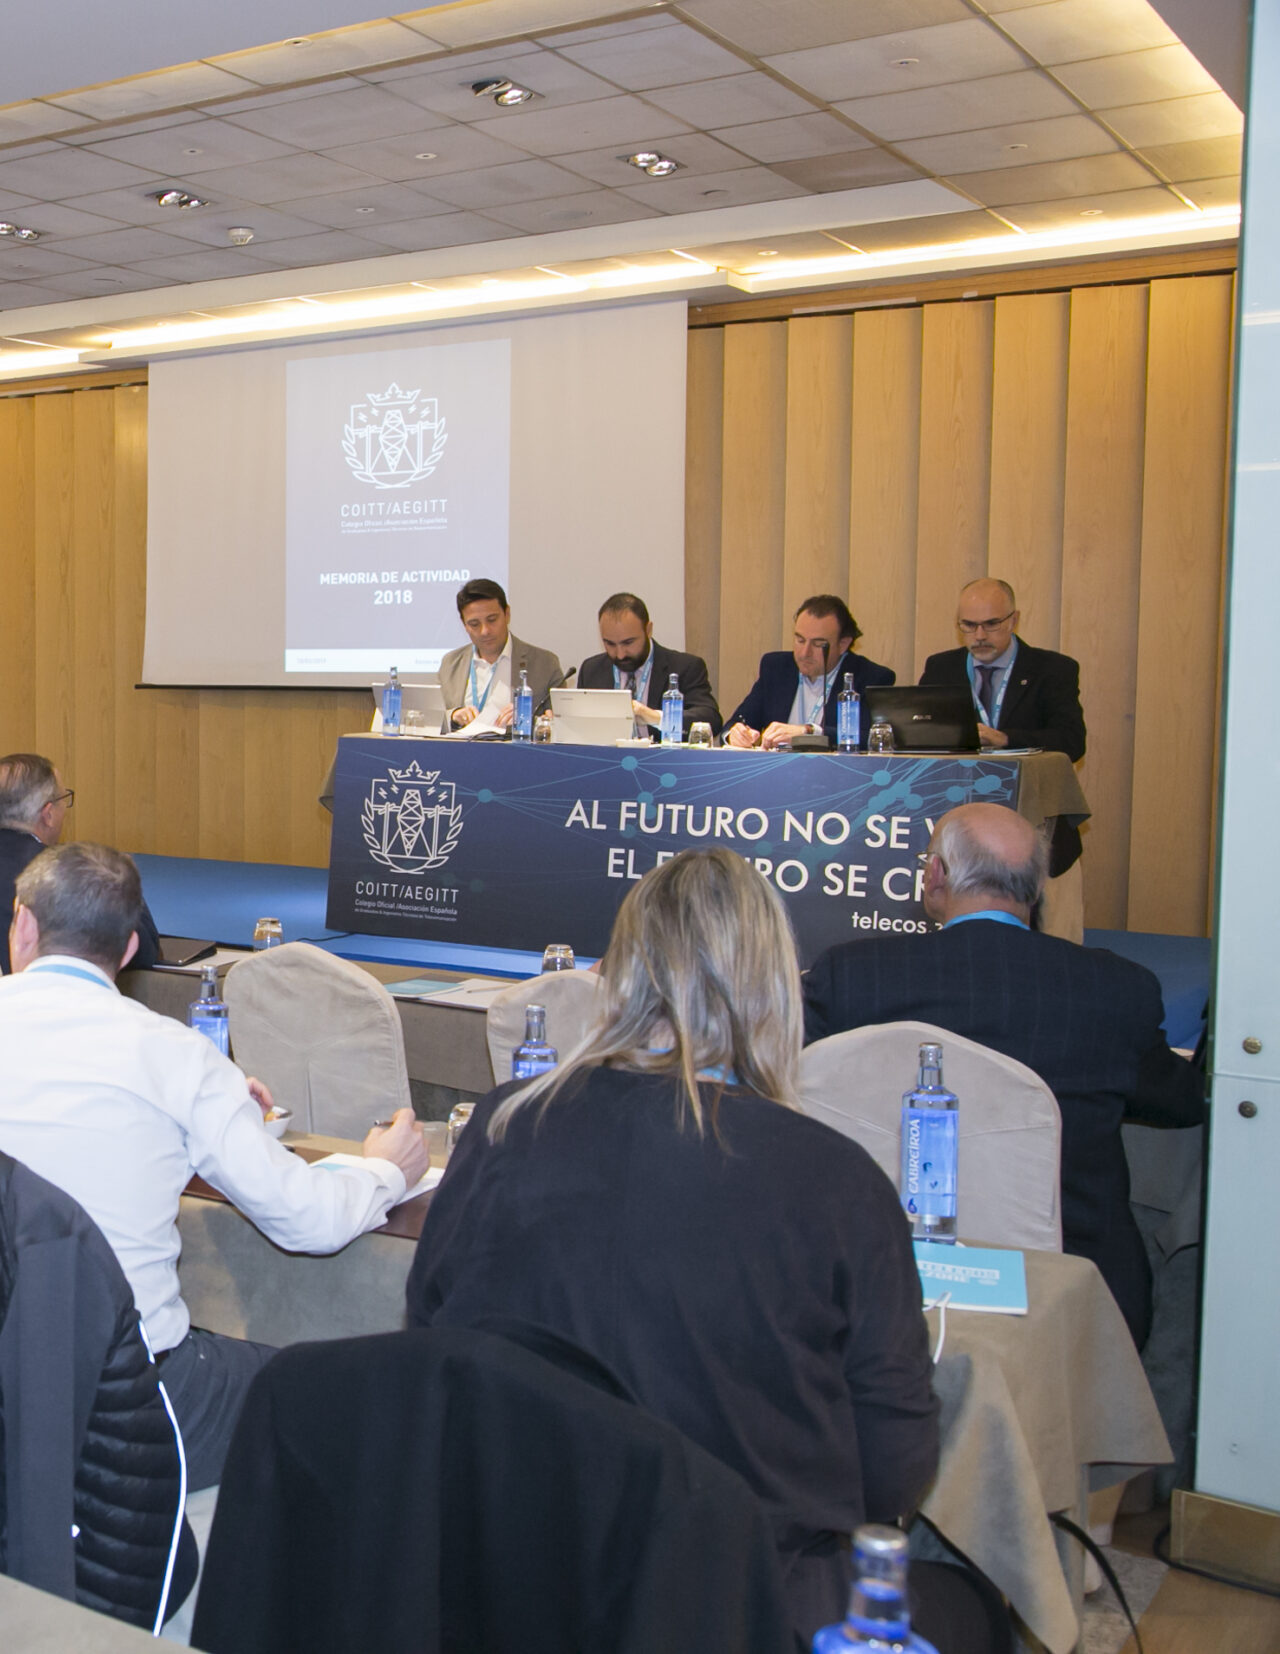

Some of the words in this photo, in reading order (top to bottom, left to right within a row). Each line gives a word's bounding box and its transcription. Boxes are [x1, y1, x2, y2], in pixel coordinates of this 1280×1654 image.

[340, 499, 448, 517] COITT/AEGITT
[320, 572, 378, 585] MEMORIA
[381, 571, 399, 583] DE
[402, 569, 471, 583] ACTIVIDAD
[374, 589, 413, 605] 2018
[564, 798, 607, 830] AL
[619, 801, 769, 841] FUTURO
[783, 809, 851, 846] NO
[864, 814, 911, 849] SE
[607, 847, 643, 880] EL
[822, 862, 868, 898] SE
[355, 881, 459, 903] COITT/AEGITT
